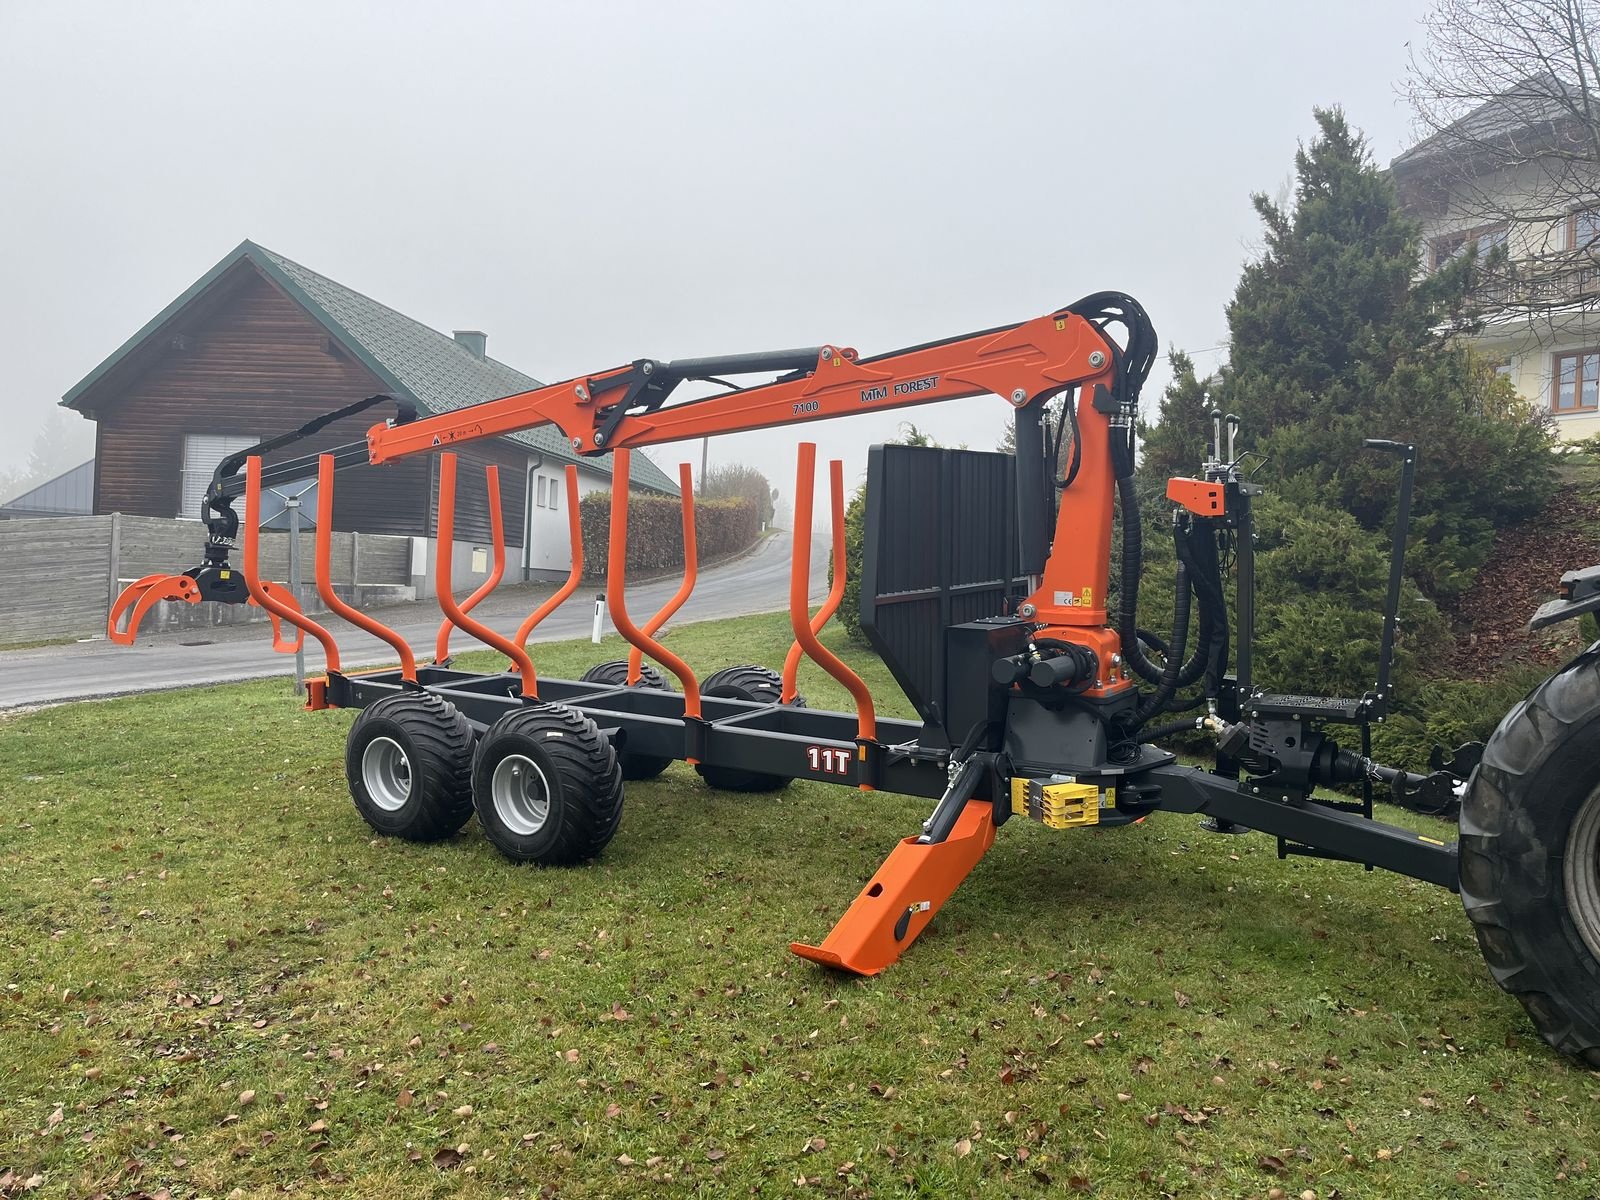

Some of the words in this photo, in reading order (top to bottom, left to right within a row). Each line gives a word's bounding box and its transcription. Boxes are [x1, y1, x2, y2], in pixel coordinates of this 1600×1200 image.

[861, 386, 888, 402] MTM
[894, 377, 938, 395] FOREST
[793, 401, 819, 415] 7100
[806, 745, 852, 775] 11T
